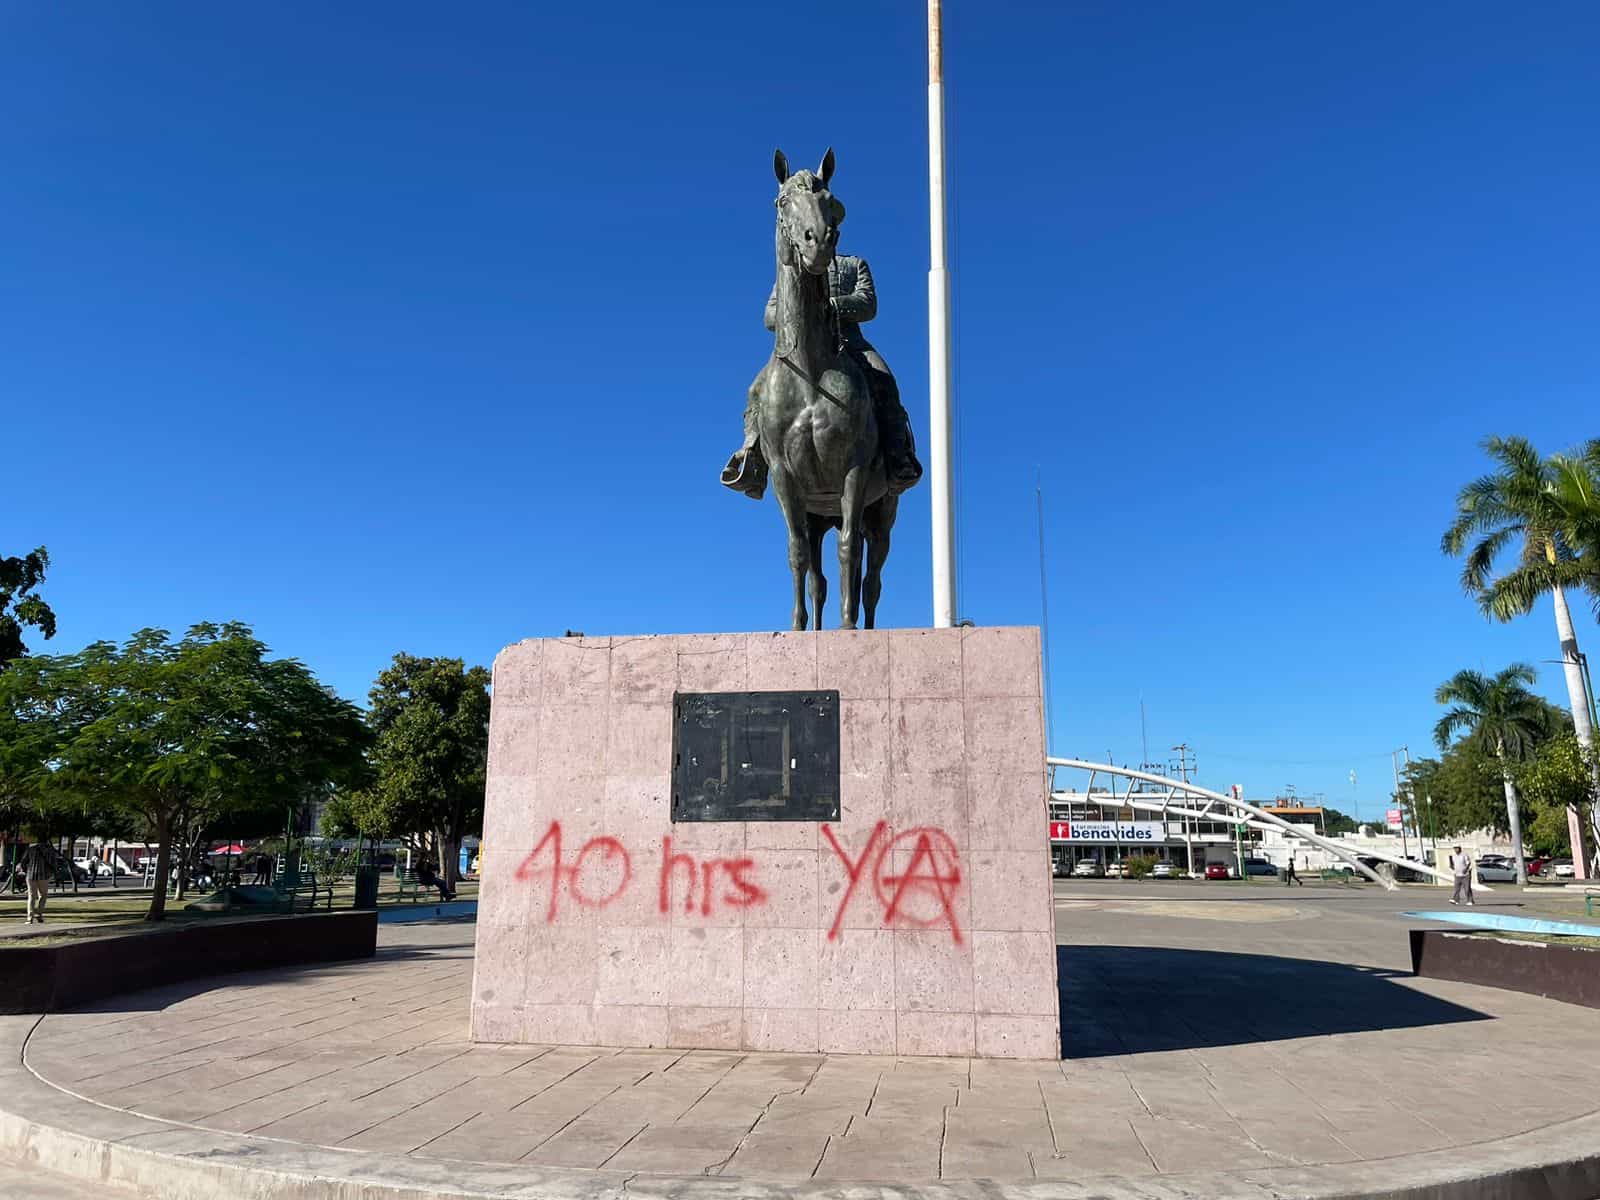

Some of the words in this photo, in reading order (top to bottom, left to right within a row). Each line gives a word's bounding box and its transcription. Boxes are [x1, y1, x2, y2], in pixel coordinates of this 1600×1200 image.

[1071, 826, 1152, 839] benavides
[514, 820, 631, 922] 40
[658, 835, 768, 916] hrs
[821, 820, 963, 945] YA
